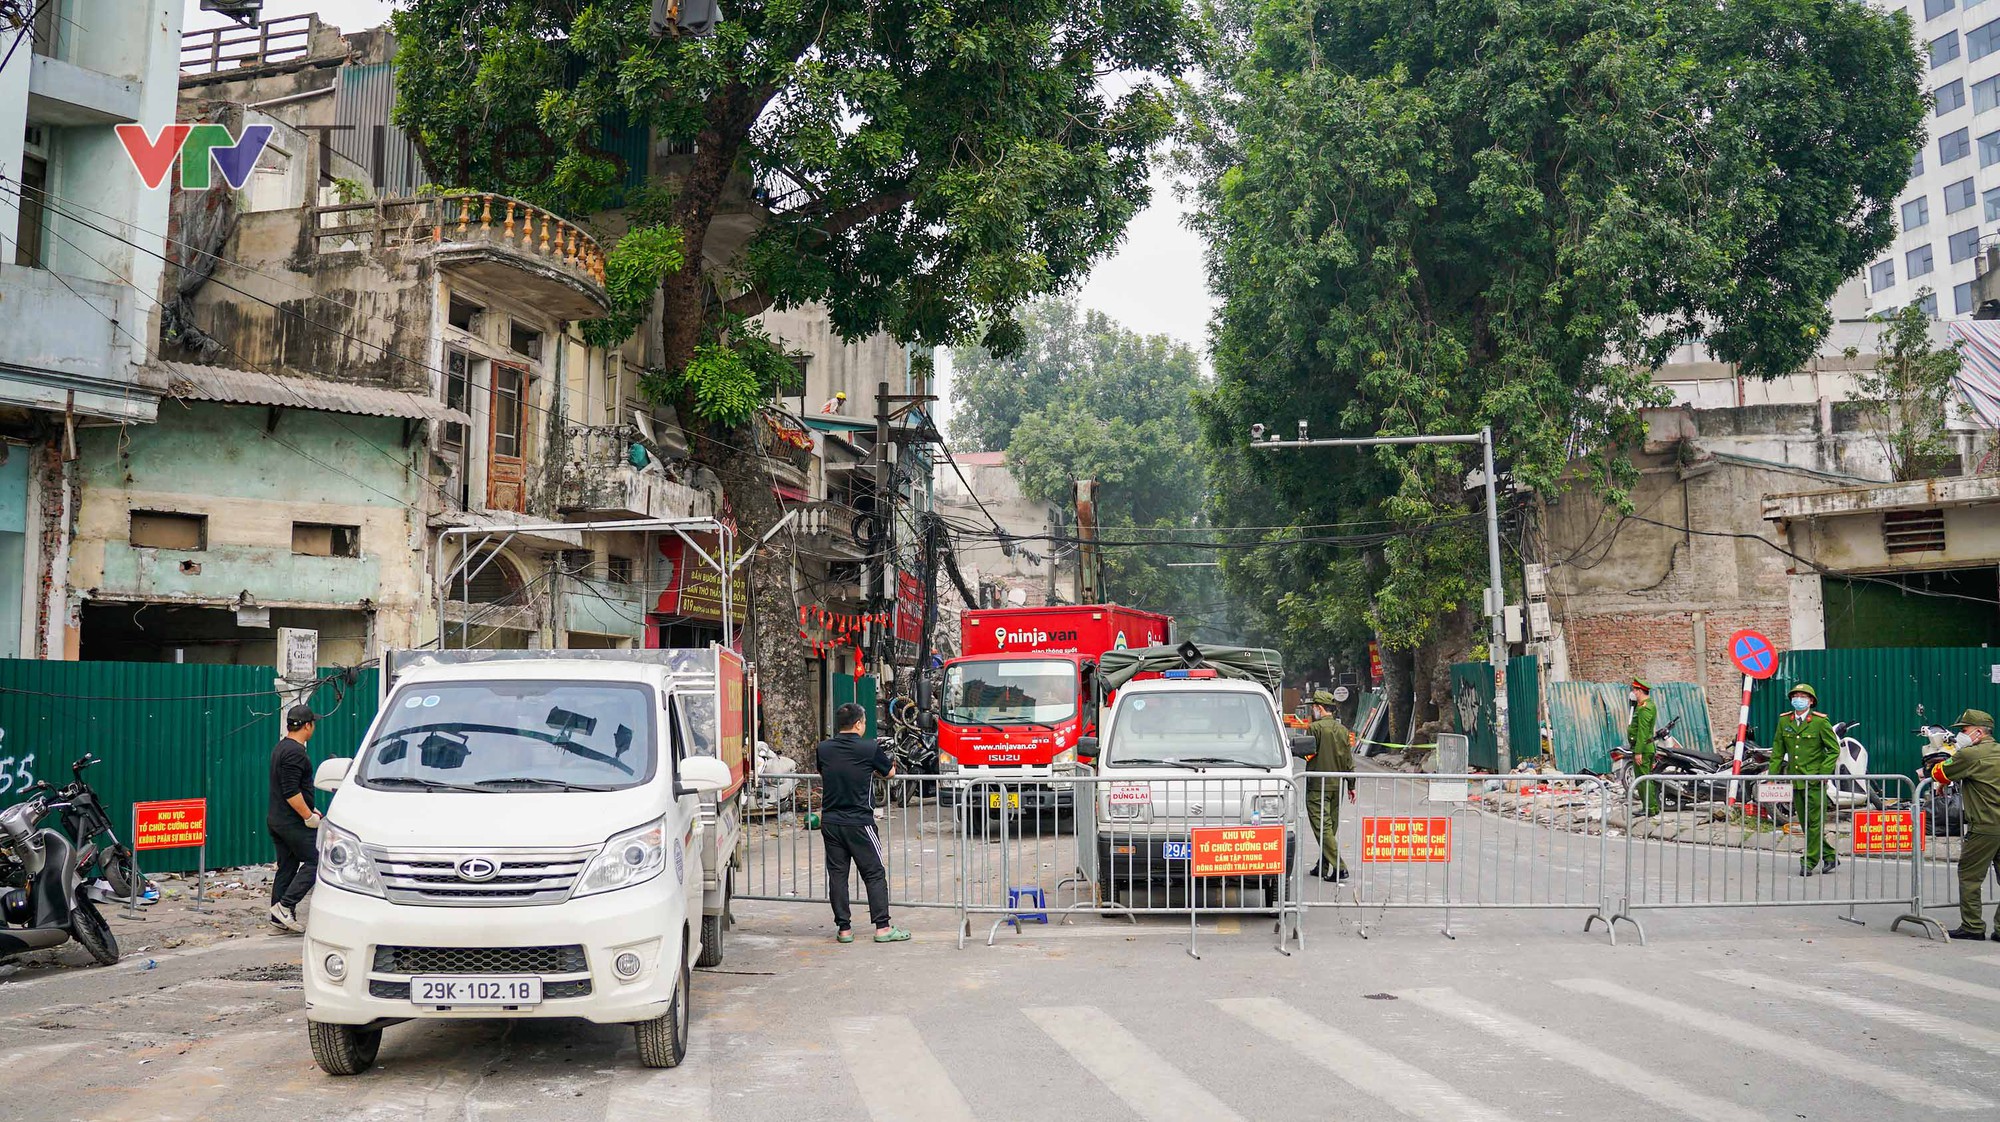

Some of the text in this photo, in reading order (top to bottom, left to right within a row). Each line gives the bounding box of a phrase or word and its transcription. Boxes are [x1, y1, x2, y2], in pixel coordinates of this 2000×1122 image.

[973, 742, 1037, 752] www.ninjavan.co
[158, 812, 171, 820] KHU
[1222, 830, 1256, 840] KHU VỰC
[1212, 842, 1232, 852] CHỨC
[1263, 839, 1278, 850] CHẾ
[1214, 854, 1229, 862] CẤM
[1230, 854, 1242, 862] TẬP
[1234, 862, 1248, 870] TRÁI
[1248, 862, 1265, 870] PHÁP
[422, 983, 530, 999] 29K-102.18
